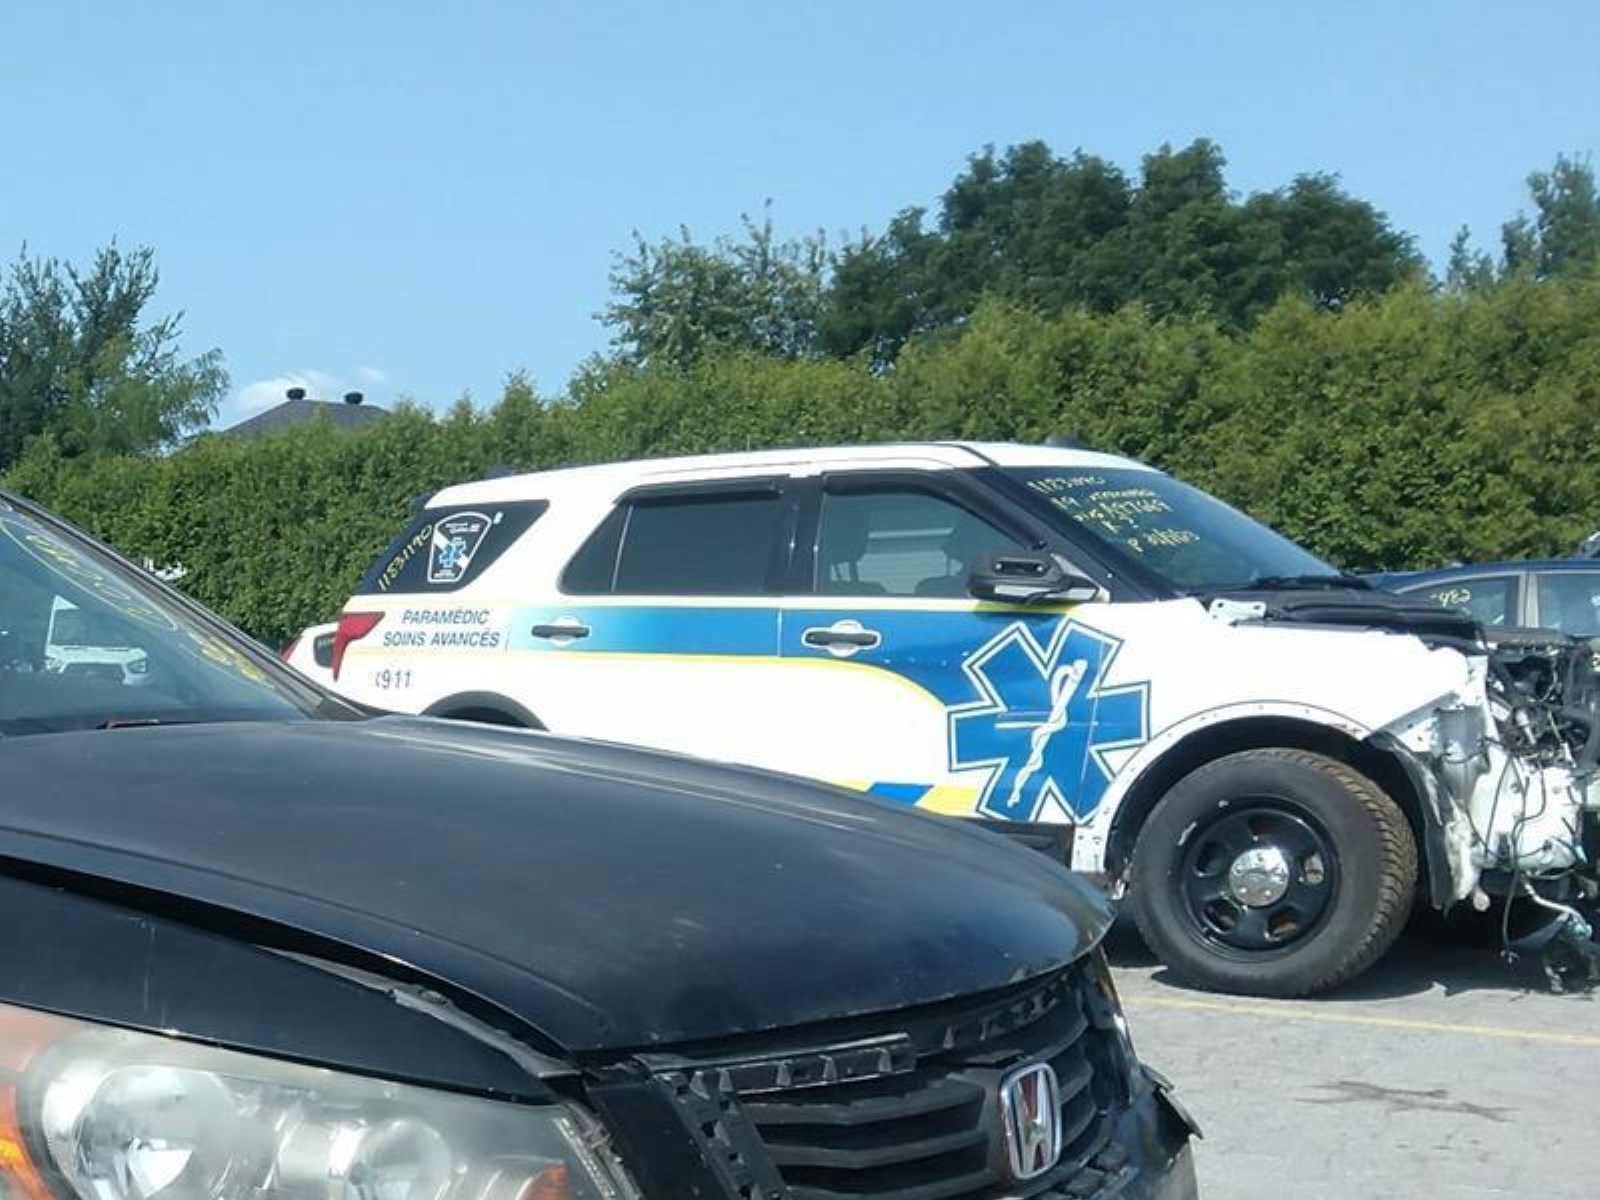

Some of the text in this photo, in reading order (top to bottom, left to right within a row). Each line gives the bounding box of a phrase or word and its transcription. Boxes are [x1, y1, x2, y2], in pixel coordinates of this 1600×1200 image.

[401, 607, 490, 624] PARAMÉDIC
[382, 628, 501, 648] SOINS AVANCÉS
